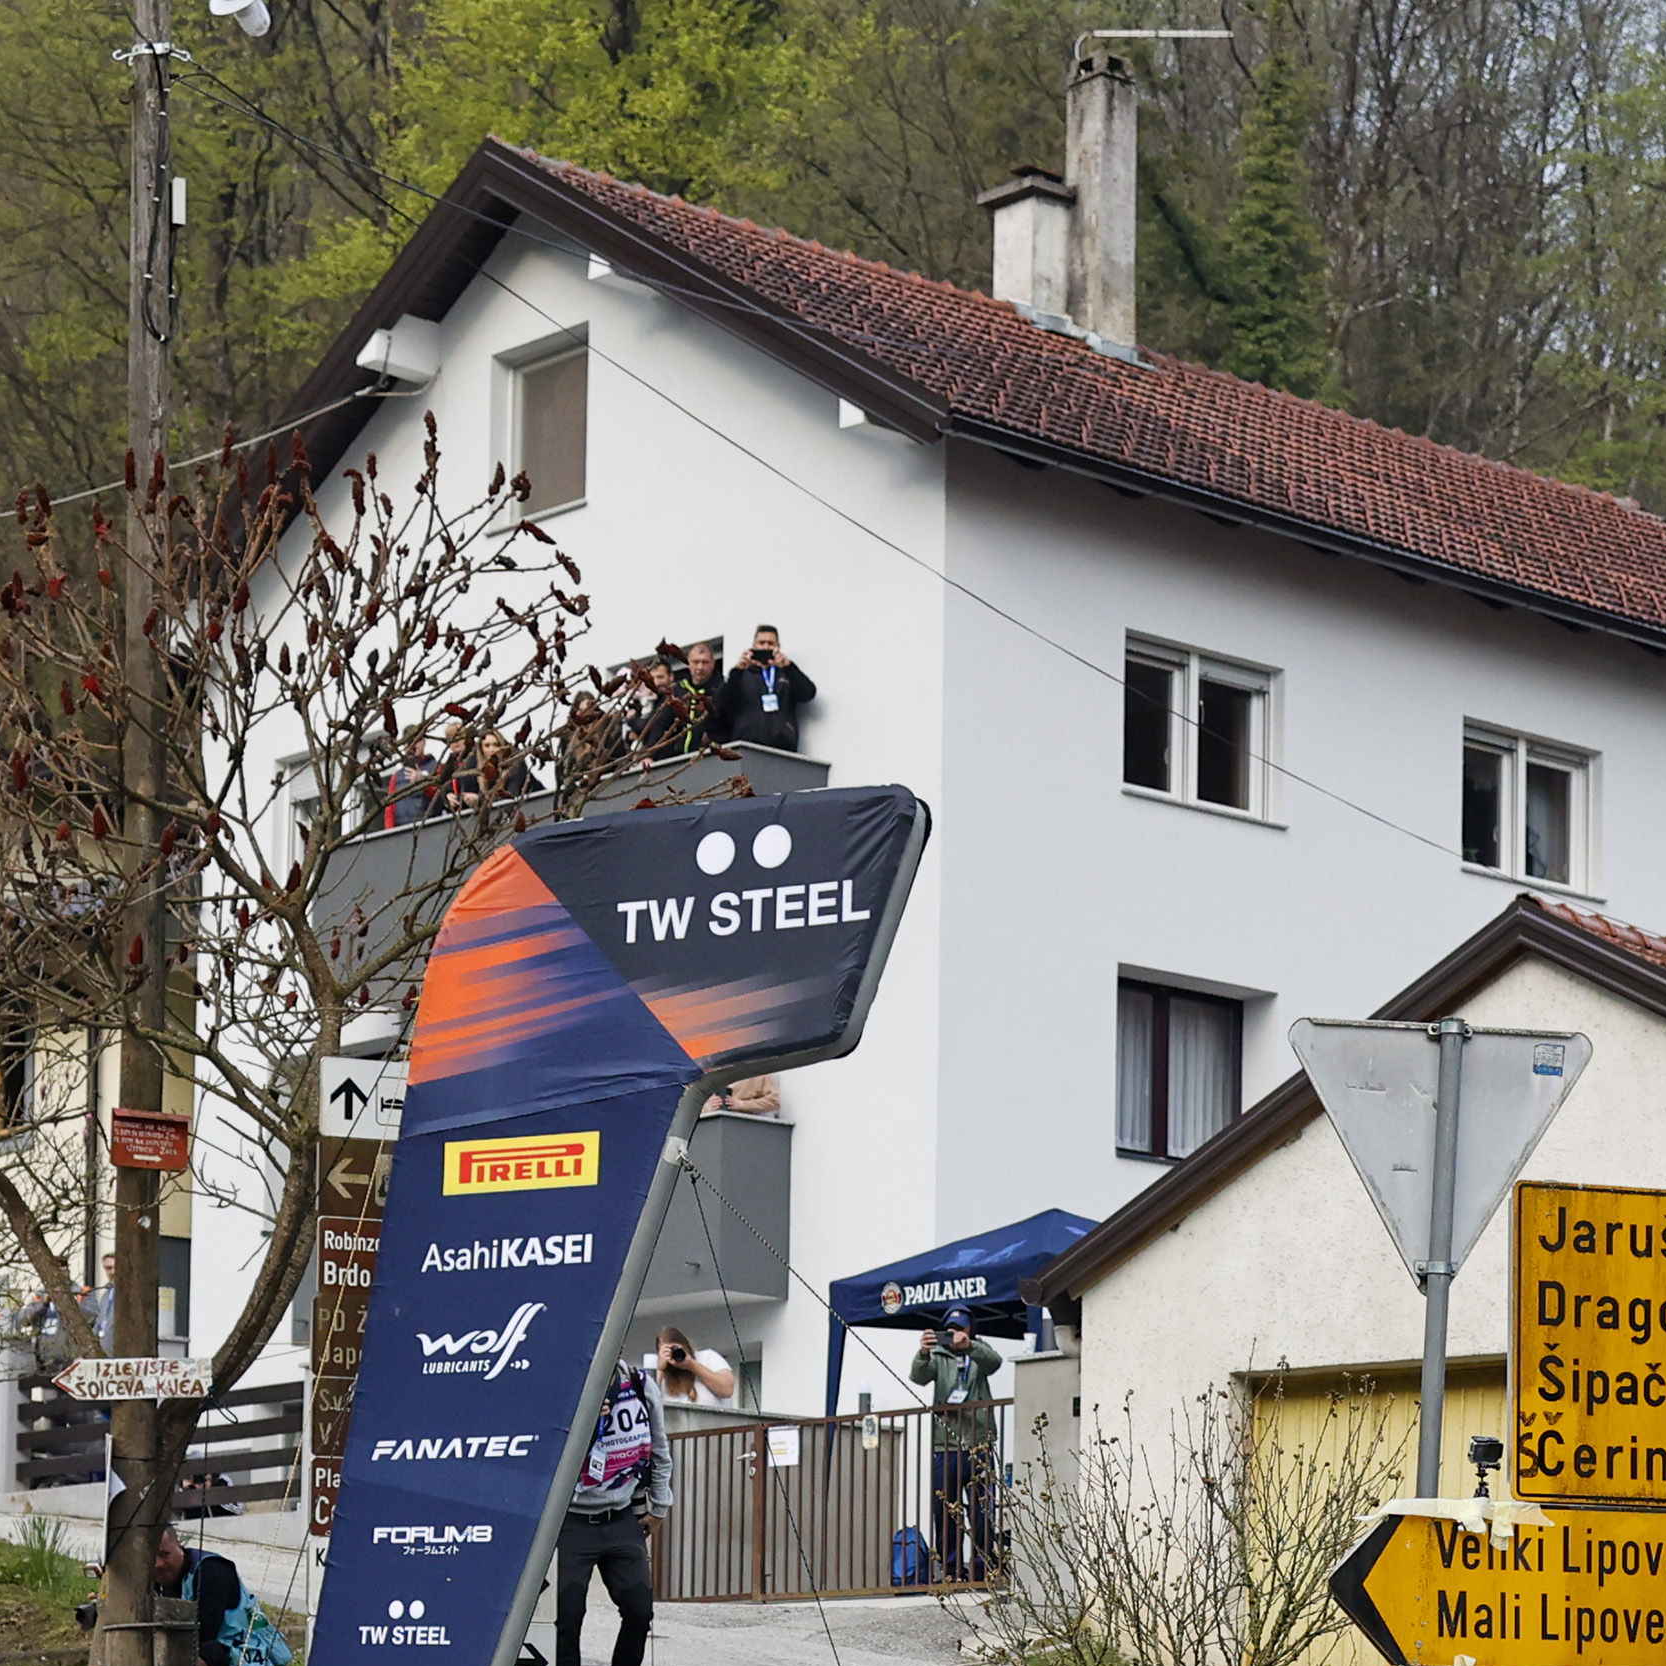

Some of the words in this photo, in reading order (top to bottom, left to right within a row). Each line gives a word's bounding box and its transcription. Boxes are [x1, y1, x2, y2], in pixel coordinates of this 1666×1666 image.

[617, 896, 695, 945] TW
[707, 879, 872, 937] STEEL
[458, 1141, 584, 1184] PIRELLI
[420, 1233, 594, 1273] AsahiKASEI
[323, 1261, 372, 1288] Brdo
[903, 1276, 988, 1307] PAULANER
[318, 1340, 363, 1370] Jap
[422, 1359, 491, 1374] LUBRICANTS
[371, 1435, 533, 1461] FANATEC
[372, 1525, 493, 1544] FORUM8
[1437, 1590, 1521, 1641] Mali
[358, 1626, 386, 1646] TW
[390, 1625, 451, 1646] STEEL
